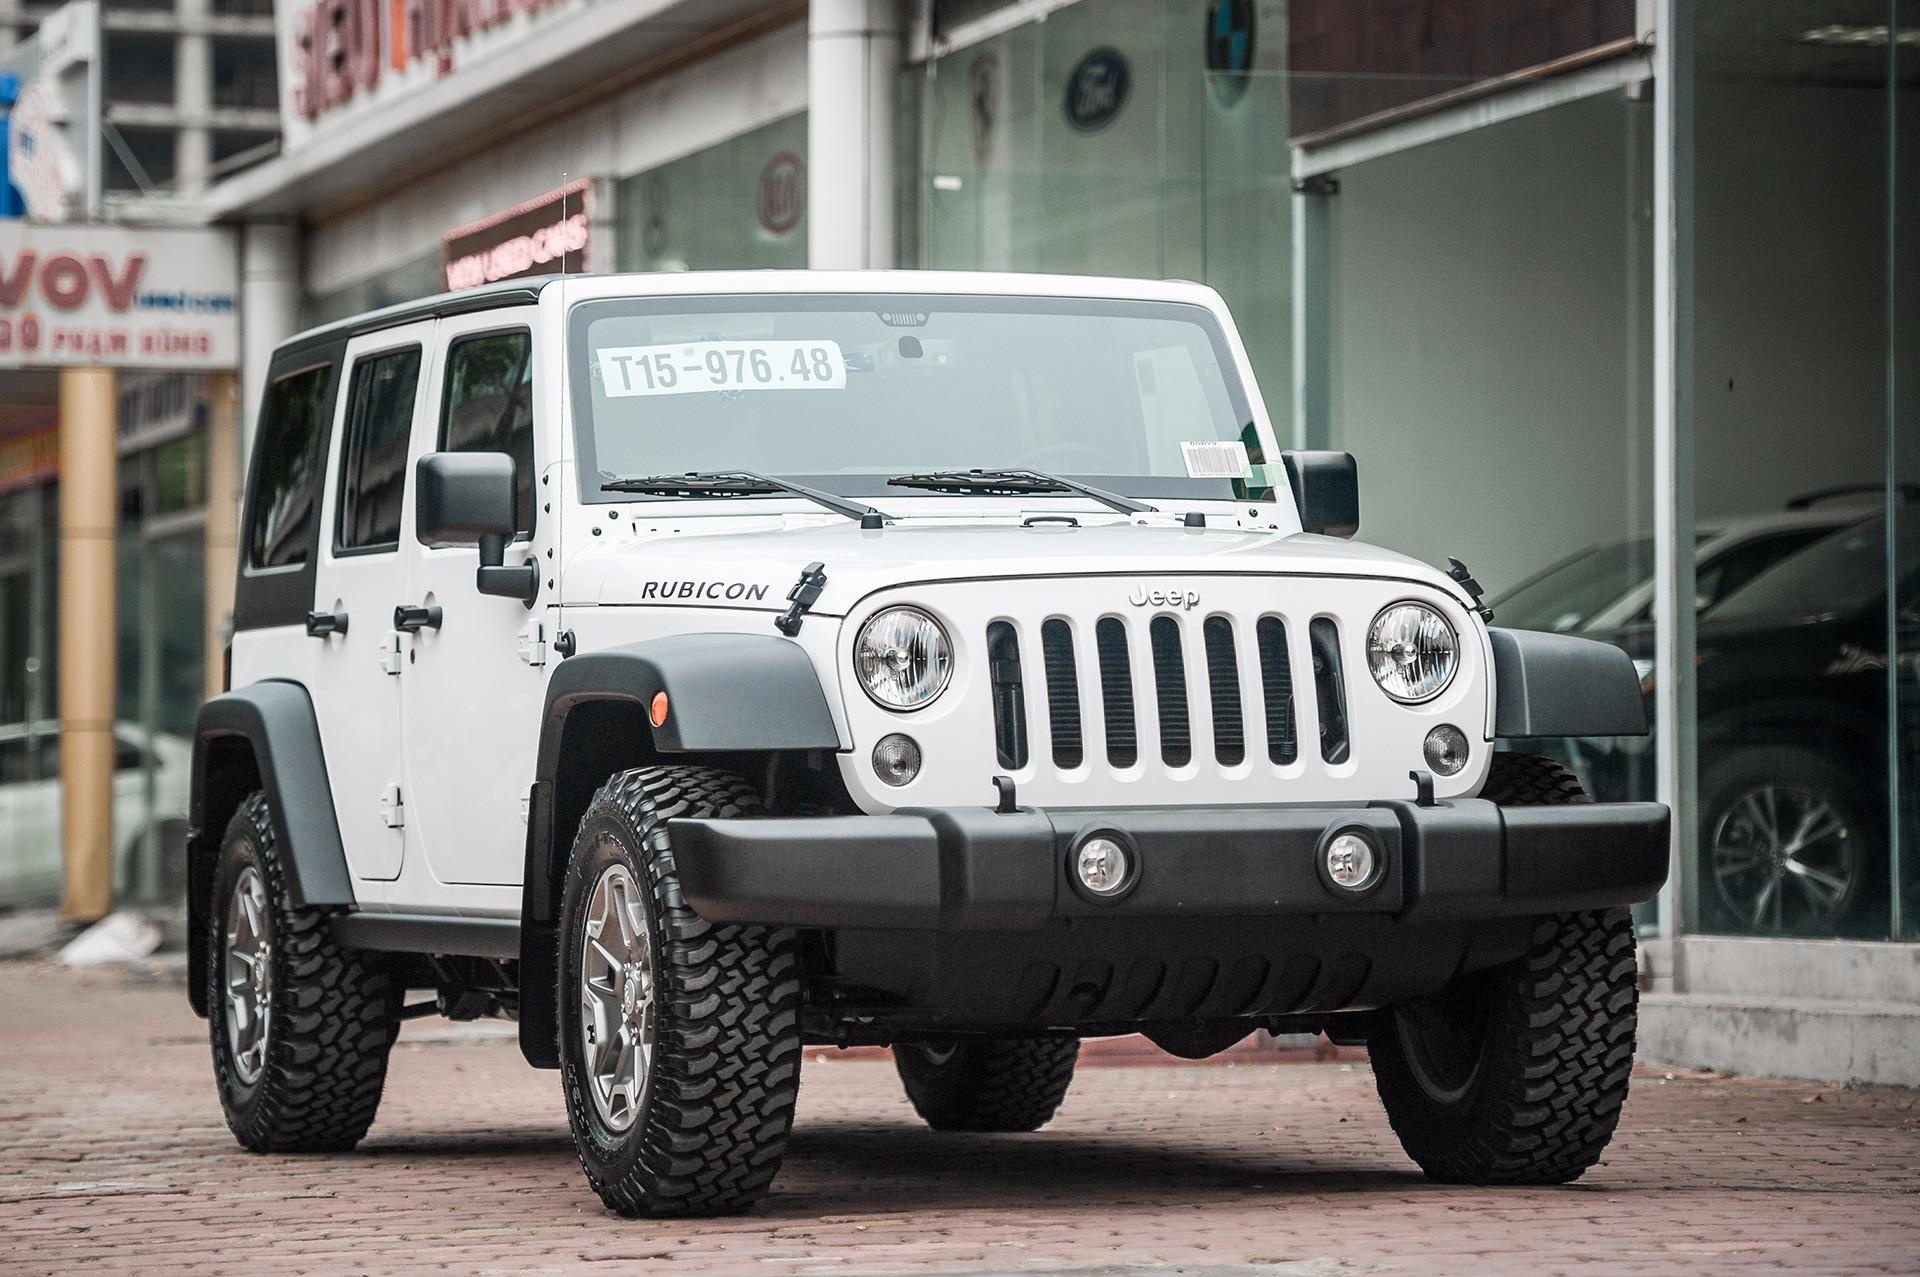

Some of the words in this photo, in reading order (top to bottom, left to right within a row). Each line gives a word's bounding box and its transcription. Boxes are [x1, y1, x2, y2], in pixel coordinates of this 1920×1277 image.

[610, 347, 833, 391] T15-976.48
[641, 581, 769, 601] RUBICON
[1128, 583, 1200, 611] Jeep
